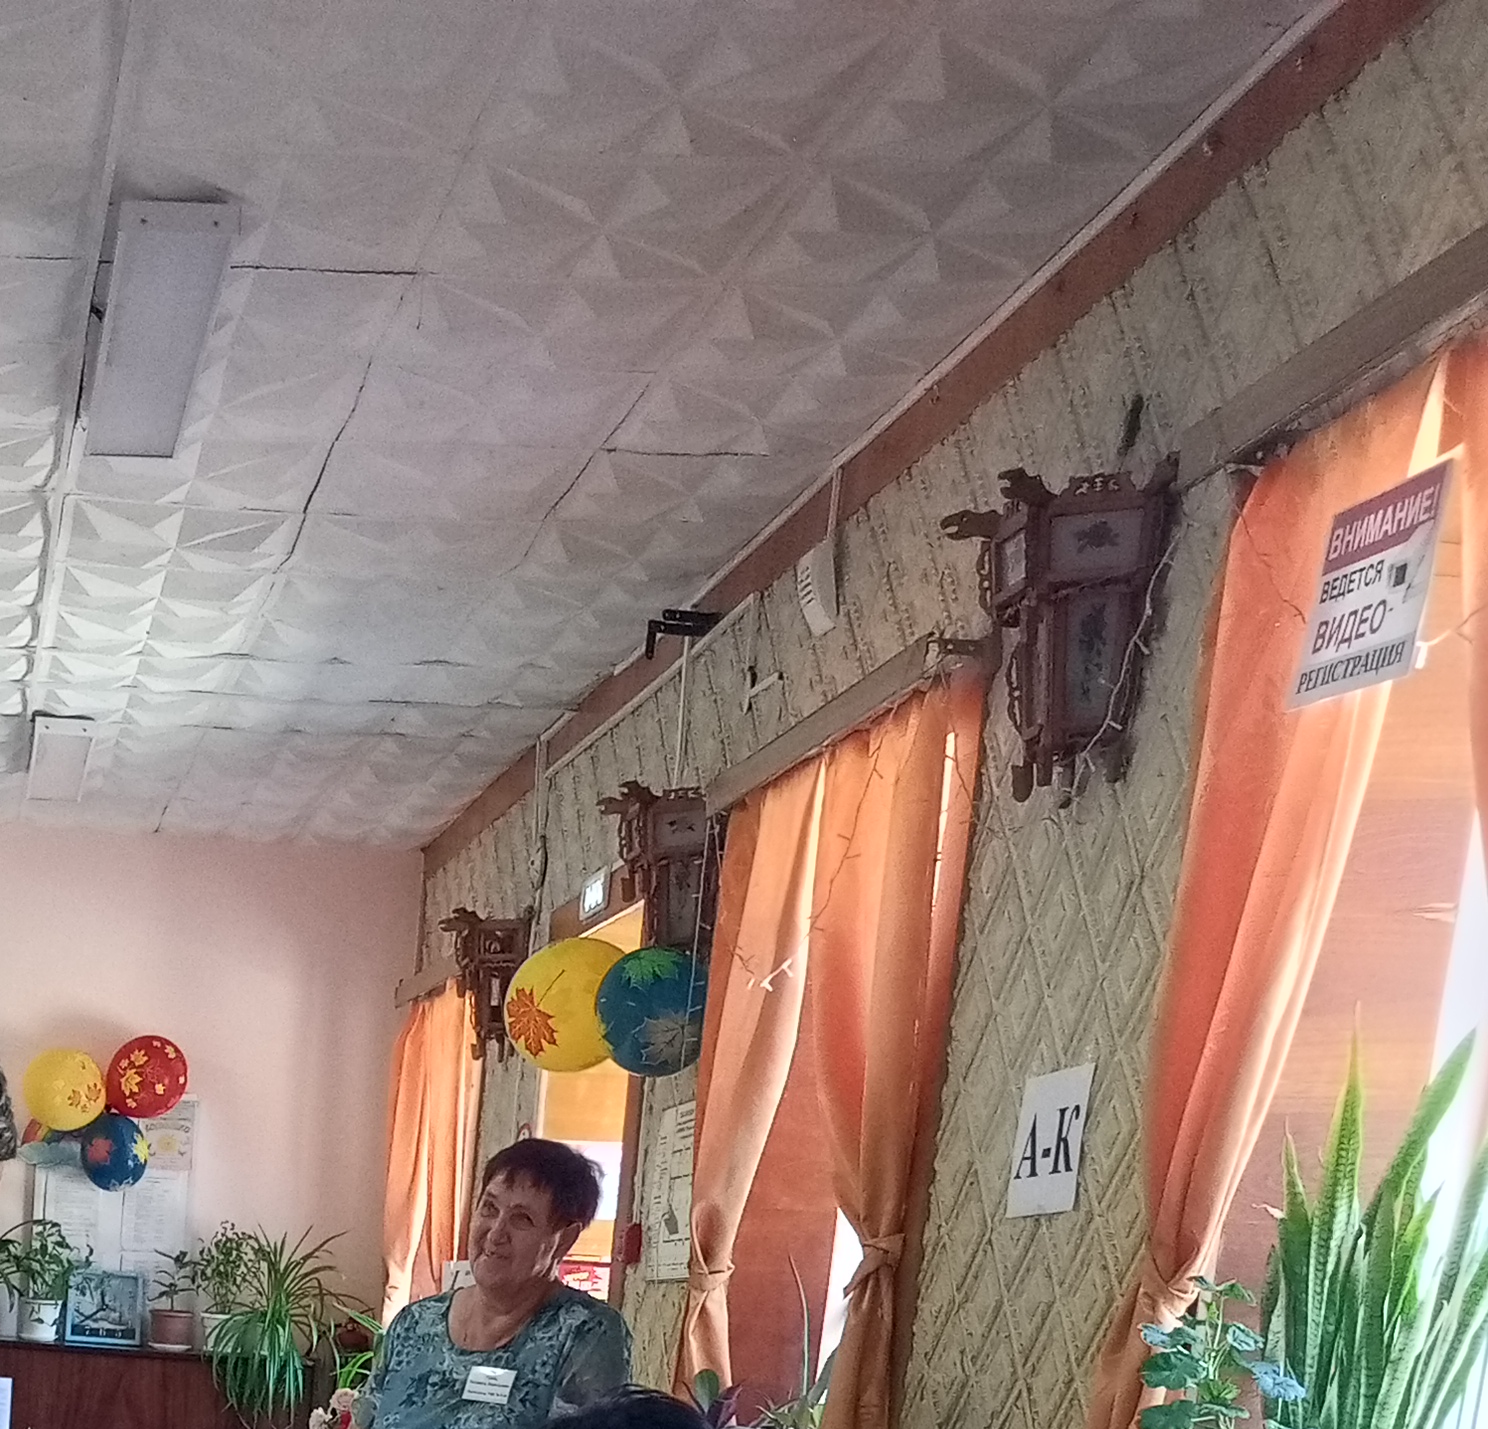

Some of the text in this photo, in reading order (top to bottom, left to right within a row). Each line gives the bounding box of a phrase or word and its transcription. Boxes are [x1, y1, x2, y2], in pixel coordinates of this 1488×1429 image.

[1327, 482, 1441, 562] ВНИМАНИЕ!
[1319, 559, 1385, 605] ВЕДЕТСЯ
[1312, 598, 1394, 655] ВИДЕО-
[1295, 640, 1407, 695] РЕГИСТРАЦИЯ
[1013, 1103, 1080, 1180] А-К
